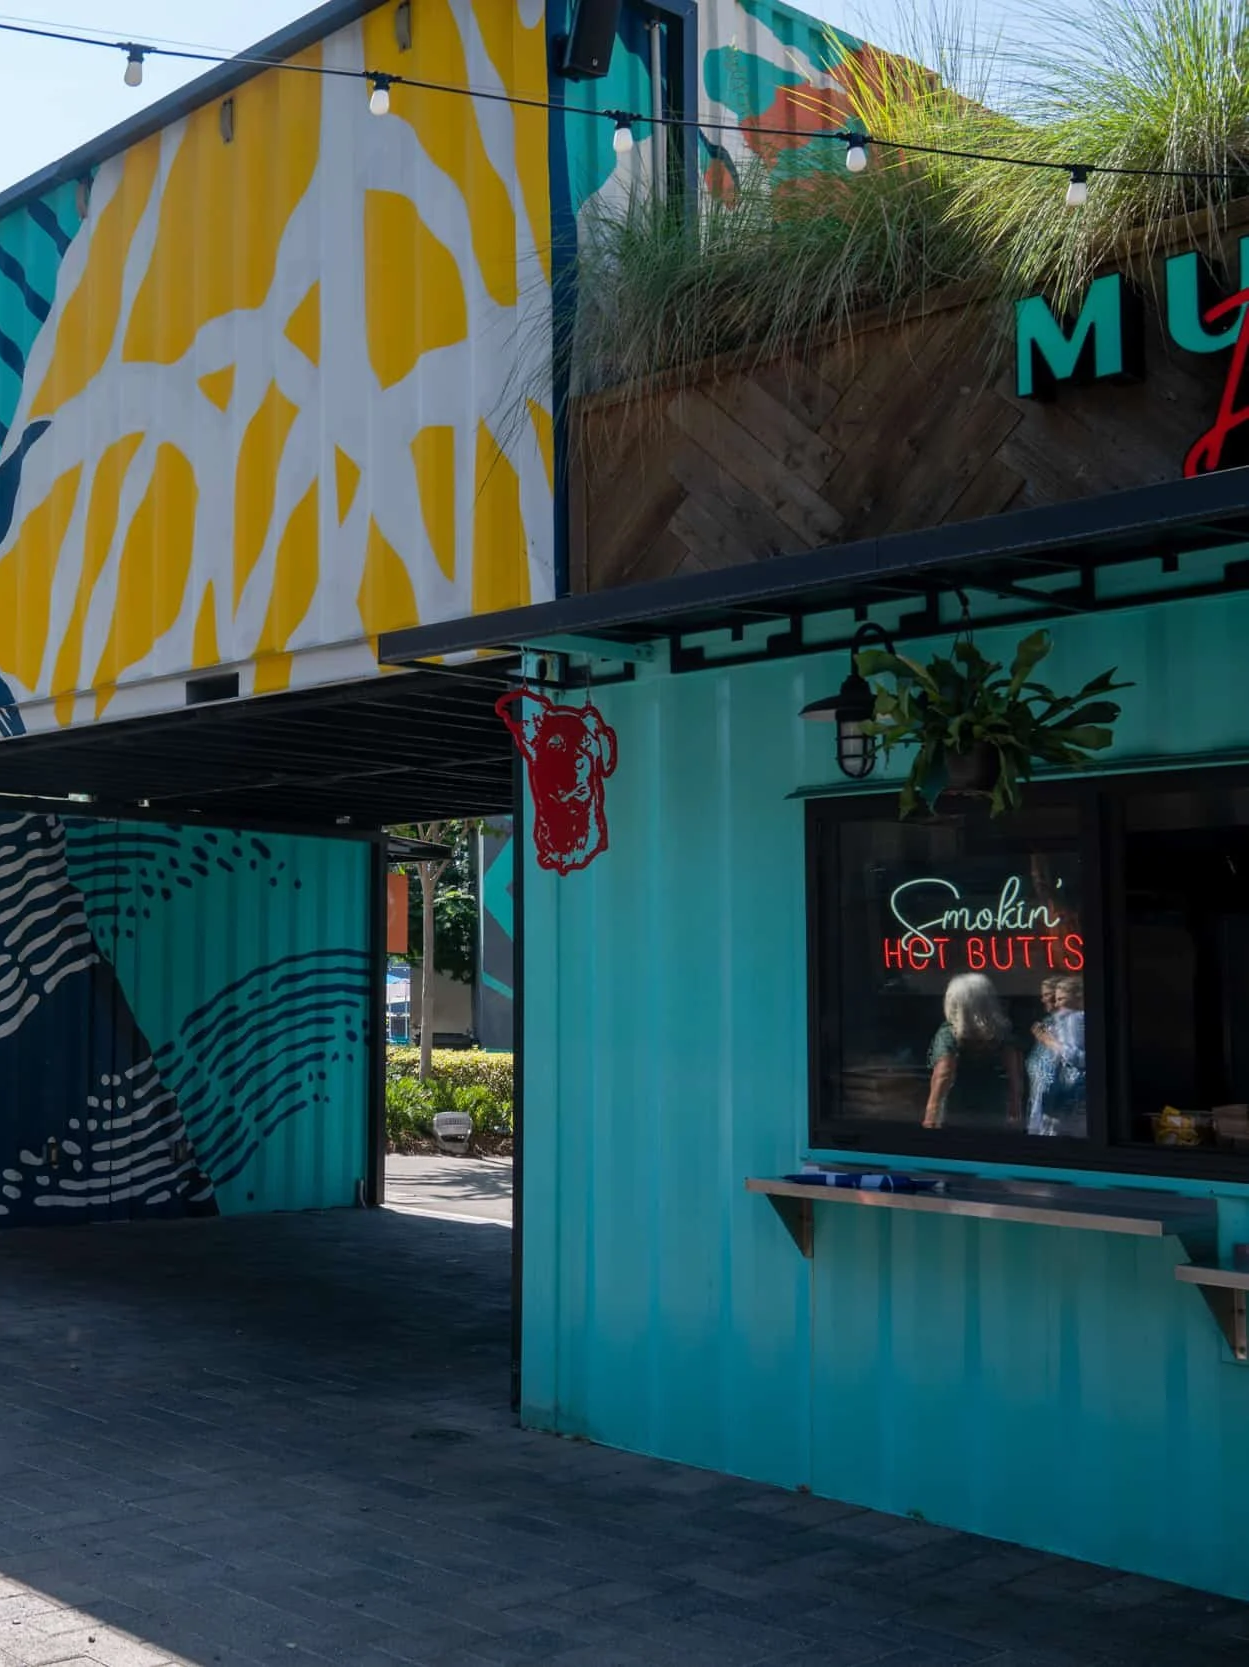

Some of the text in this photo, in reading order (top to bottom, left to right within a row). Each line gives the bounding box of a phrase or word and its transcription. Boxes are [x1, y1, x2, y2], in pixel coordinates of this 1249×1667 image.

[890, 875, 1063, 957] Smokin'
[883, 934, 1085, 970] HOT BUTTS
